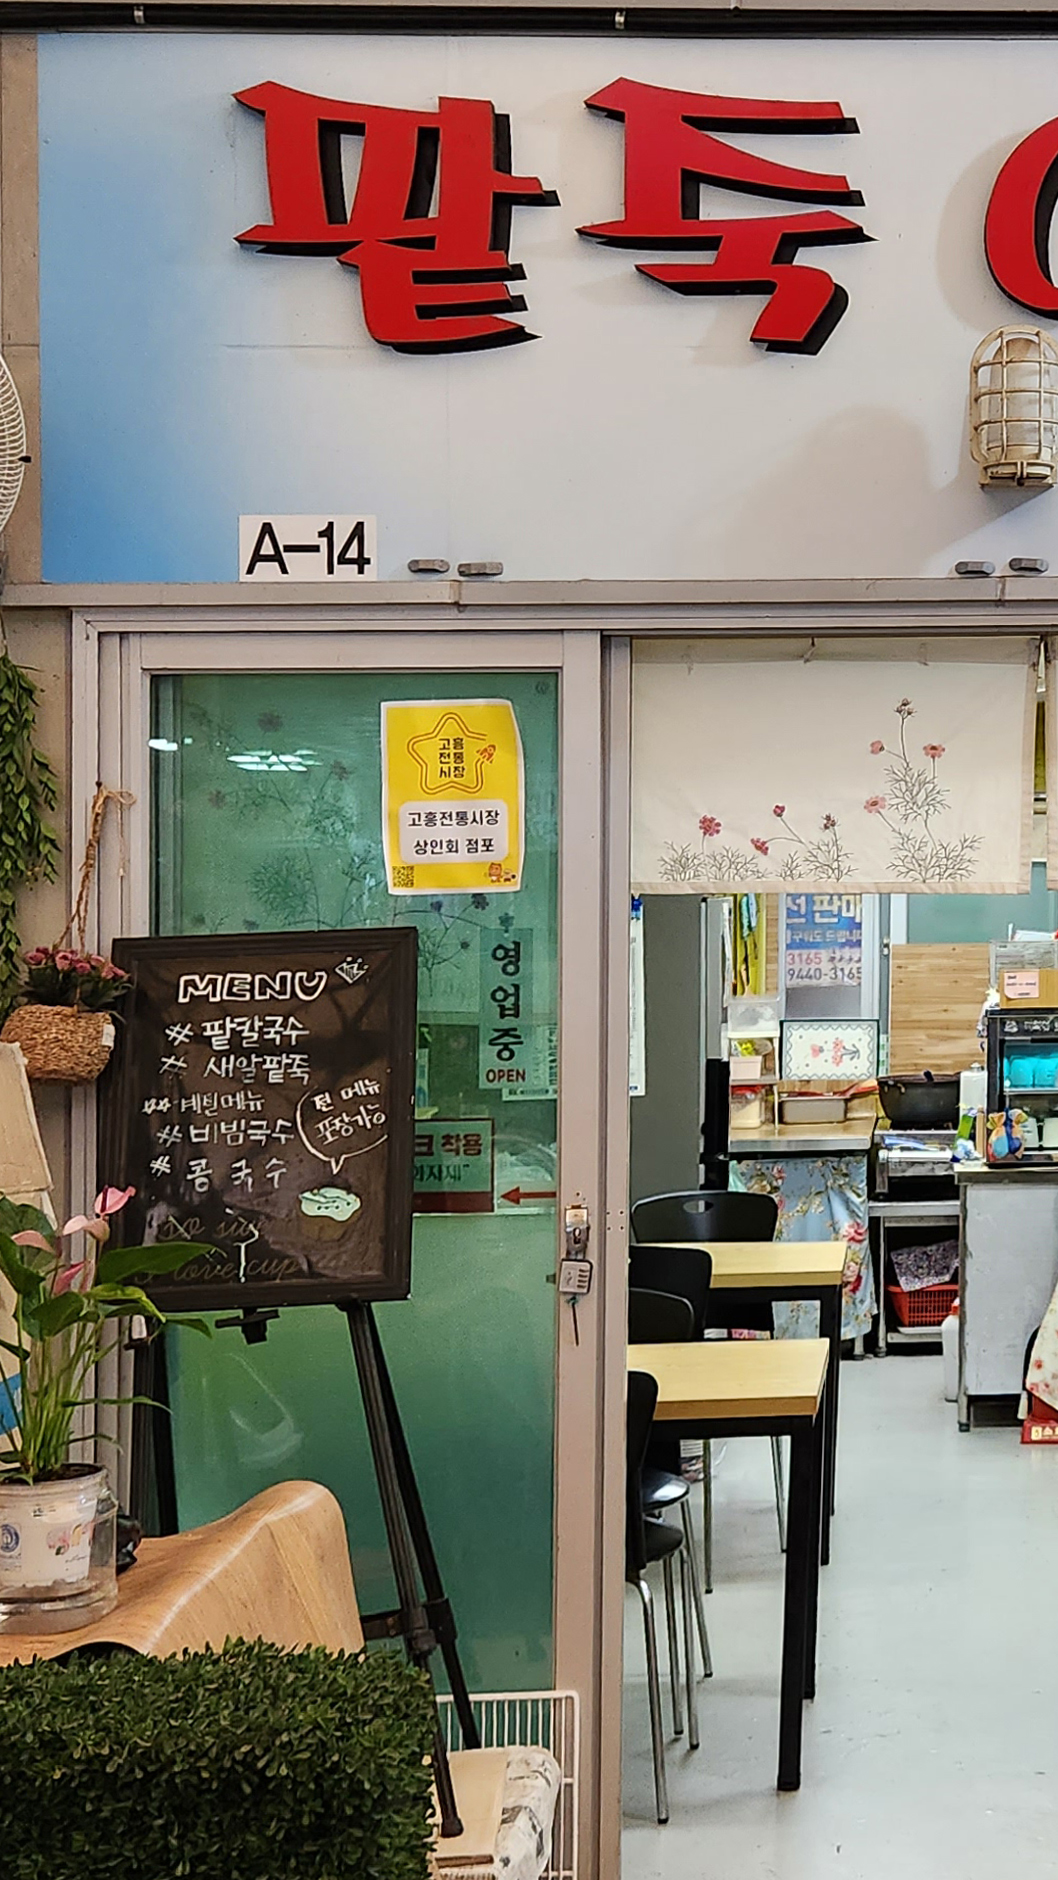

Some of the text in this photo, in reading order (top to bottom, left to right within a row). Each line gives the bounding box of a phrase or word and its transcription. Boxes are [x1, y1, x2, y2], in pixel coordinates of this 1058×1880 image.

[232, 76, 880, 356] 팥죽
[245, 521, 371, 575] A-14
[438, 737, 464, 750] 고흥
[438, 751, 464, 765] 전통
[439, 765, 465, 778] 시장
[407, 809, 500, 827] 고흥전통시장
[413, 838, 495, 855] 상인회 점포
[787, 952, 822, 966] 3165
[178, 971, 327, 1003] MENU
[488, 940, 524, 1062] 영업중
[201, 1015, 310, 1051] 팥칼국수
[203, 1053, 311, 1085] 새알팥죽
[486, 1069, 526, 1083] OPEN
[311, 1079, 381, 1112] 전 메뉴
[189, 1118, 295, 1147] 비빔국수
[314, 1104, 386, 1145] 포장가능
[441, 1133, 482, 1156] 착용
